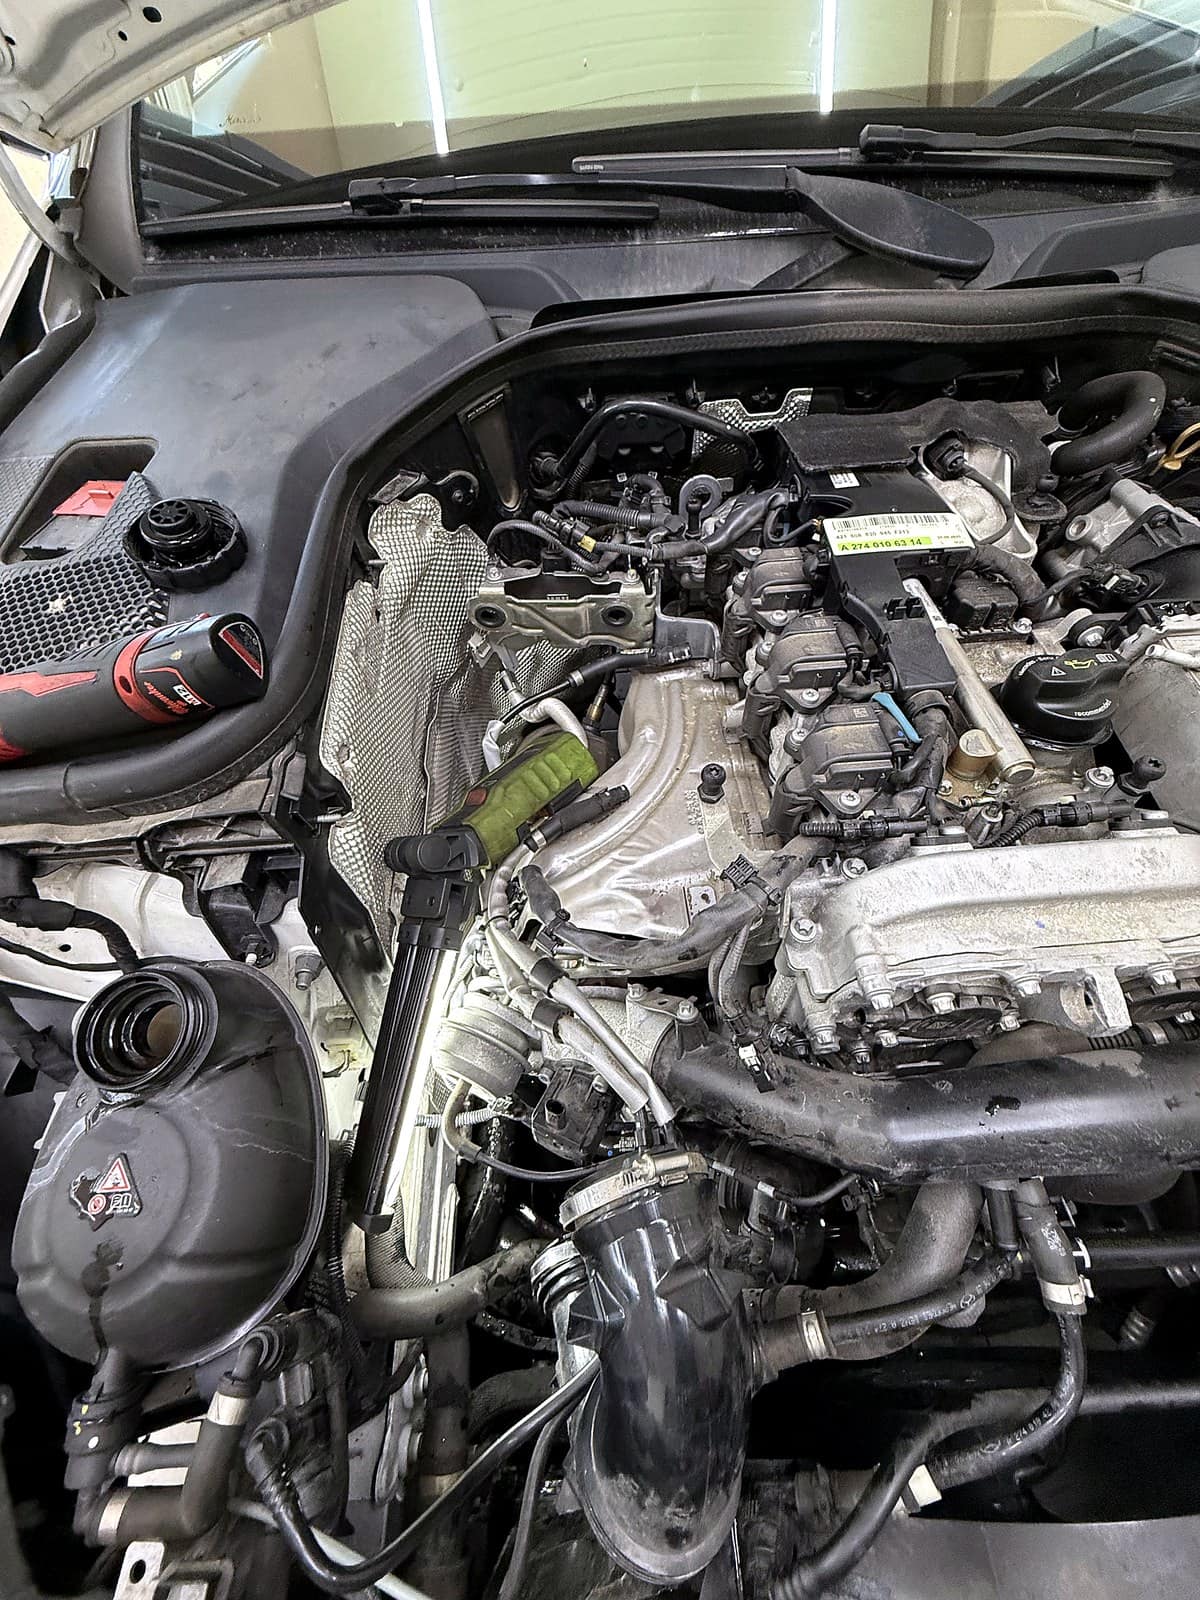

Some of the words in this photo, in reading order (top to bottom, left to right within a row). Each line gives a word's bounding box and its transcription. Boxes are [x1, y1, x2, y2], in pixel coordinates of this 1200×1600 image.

[851, 542, 870, 550] 274
[873, 541, 892, 549] 010
[894, 539, 908, 547] 63
[910, 538, 923, 546] 14
